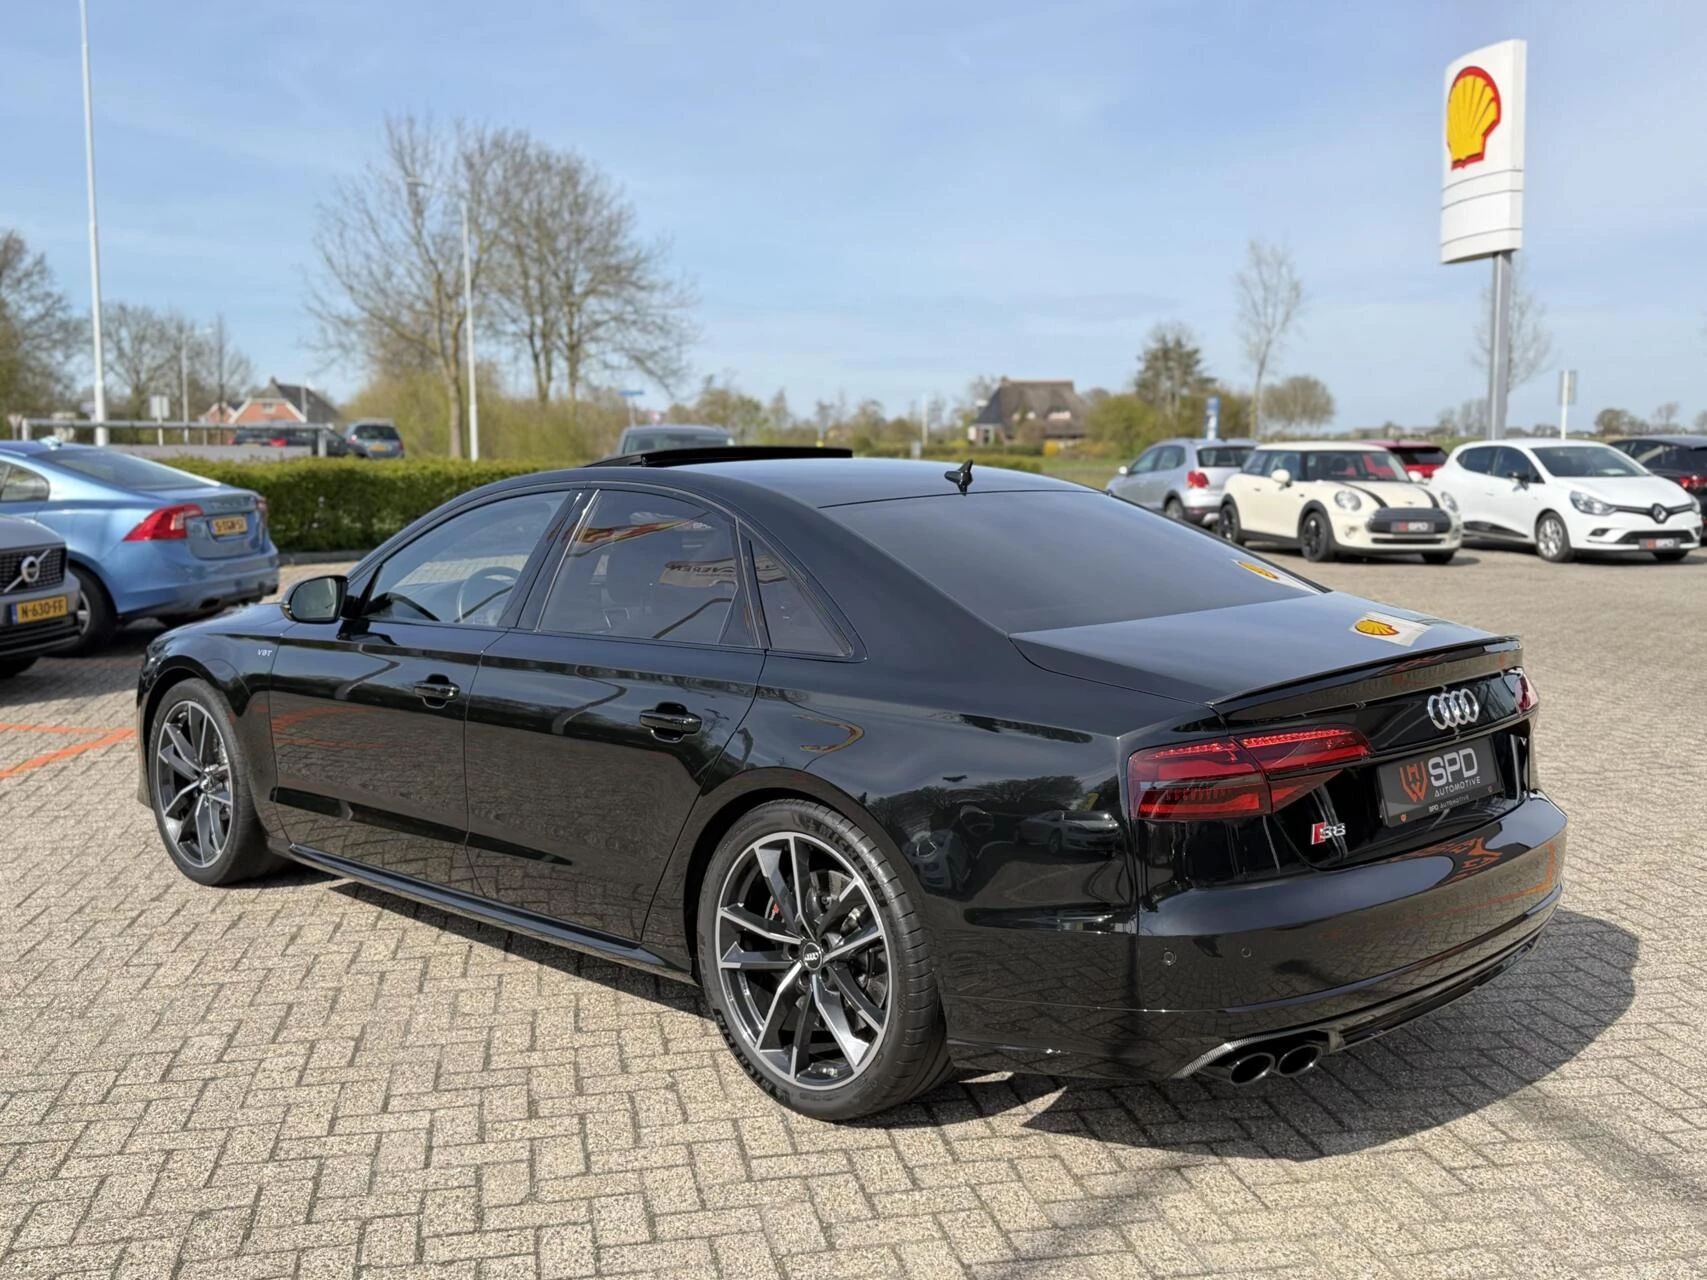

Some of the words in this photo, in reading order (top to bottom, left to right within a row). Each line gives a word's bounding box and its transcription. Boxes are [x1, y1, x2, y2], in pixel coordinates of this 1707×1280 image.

[20, 598, 65, 619] N-630-FF
[1428, 747, 1478, 787] SPD
[1434, 776, 1481, 798] AUTOMOTIVE
